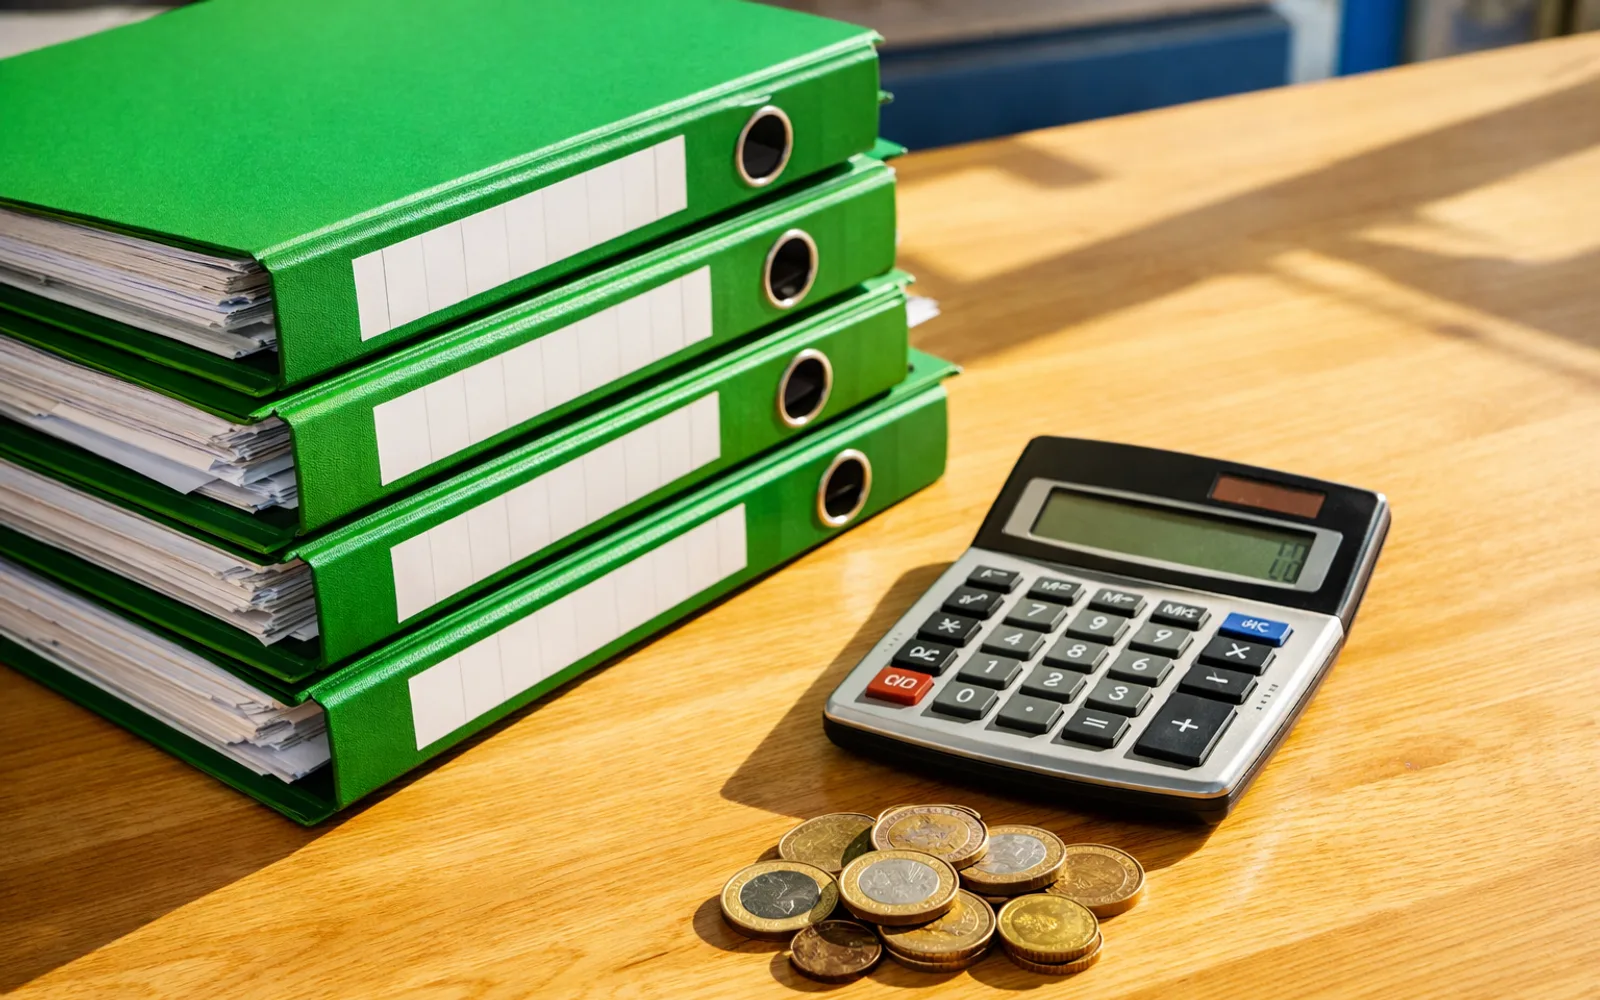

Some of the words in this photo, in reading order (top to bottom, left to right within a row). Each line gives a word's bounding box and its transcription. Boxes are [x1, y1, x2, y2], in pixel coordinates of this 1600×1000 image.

[1028, 604, 1047, 616] 7
[1090, 616, 1107, 629] 9
[1004, 633, 1023, 645] 4
[1154, 630, 1172, 642] 9
[1067, 645, 1086, 657] 8
[985, 661, 997, 673] 1
[1132, 658, 1149, 670] 6
[1044, 673, 1063, 686] 2
[957, 689, 974, 702] 0
[1109, 686, 1128, 700] 3
